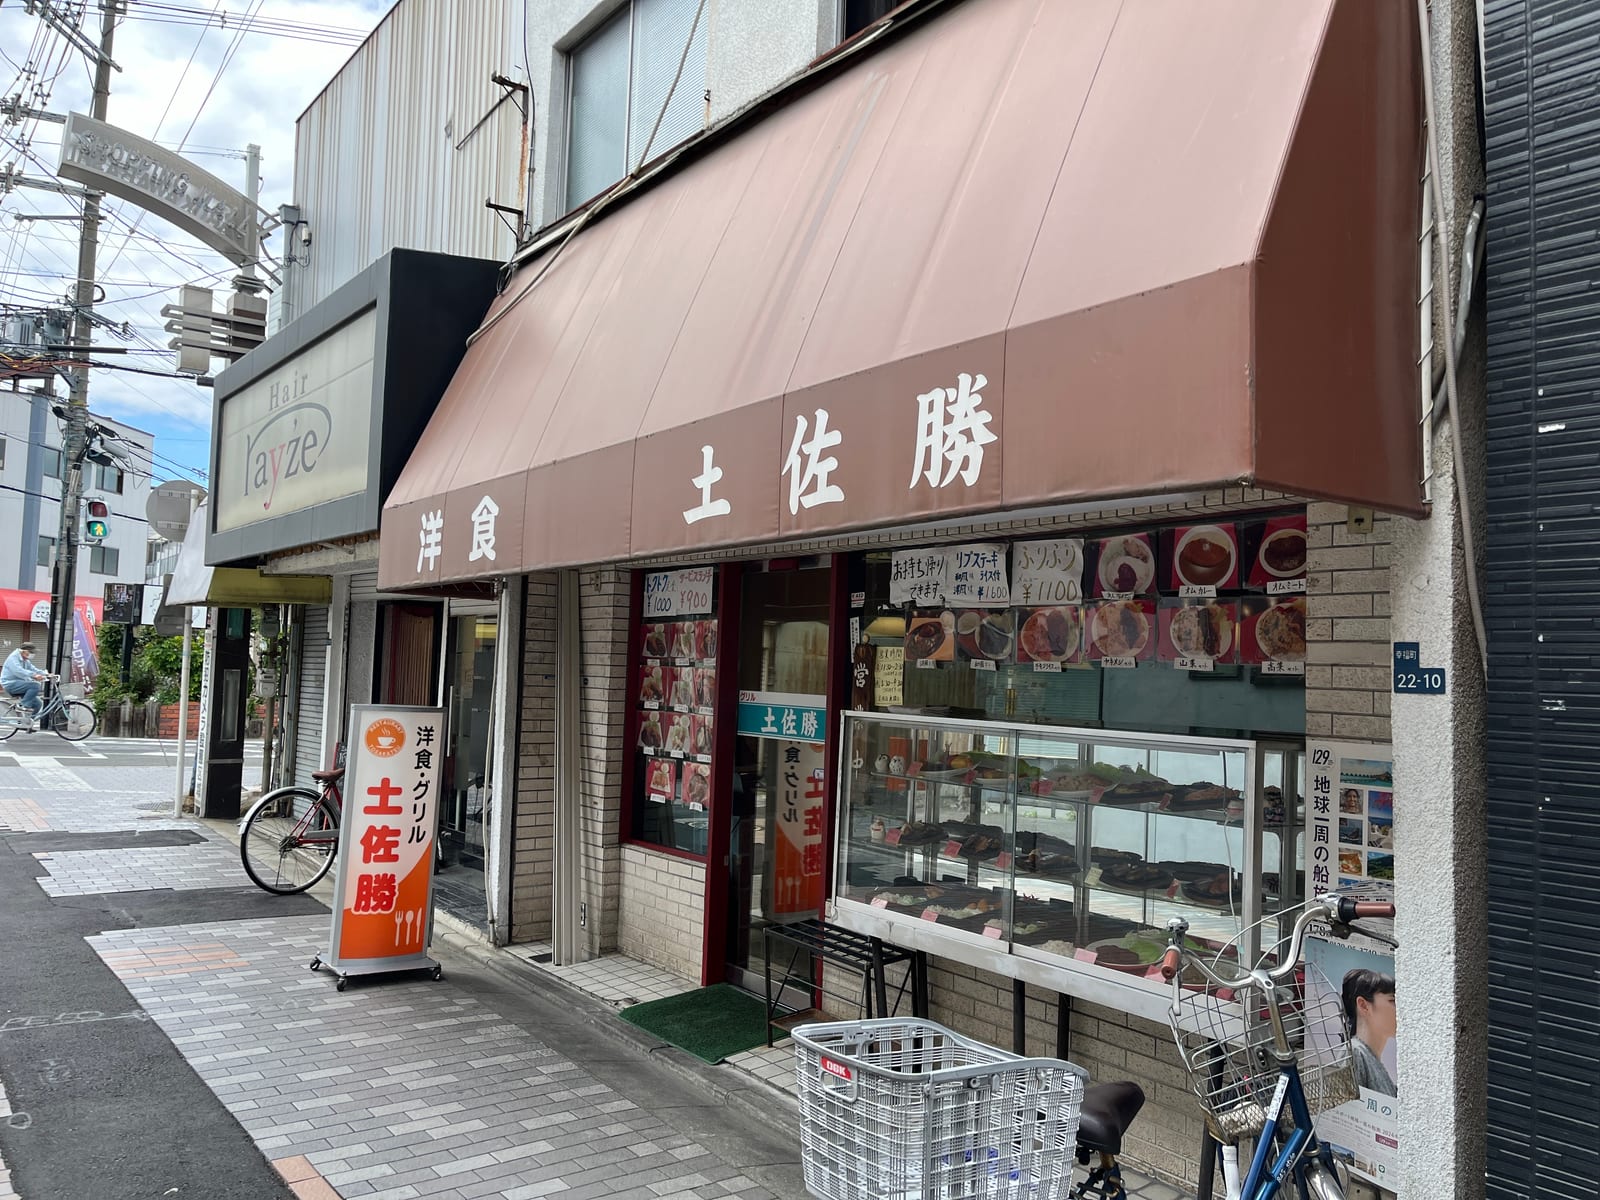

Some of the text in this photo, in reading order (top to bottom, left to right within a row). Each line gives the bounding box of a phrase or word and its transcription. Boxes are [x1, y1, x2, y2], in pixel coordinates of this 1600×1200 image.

[269, 369, 308, 411] Hair
[416, 372, 998, 574] 洋食 土佐勝
[893, 556, 945, 581] お持ち帰り
[680, 590, 708, 612] ¥900
[909, 581, 946, 601] できます。
[977, 585, 1008, 601] ¥1600
[1022, 579, 1078, 604] ¥1100
[647, 594, 672, 614] ¥1000
[1397, 673, 1441, 689] 22-10
[740, 691, 757, 702] グリル
[761, 707, 819, 738] 土佐勝
[1312, 749, 1331, 765] 129
[407, 725, 435, 845] 洋食・グリル
[353, 776, 404, 914] 土佐勝
